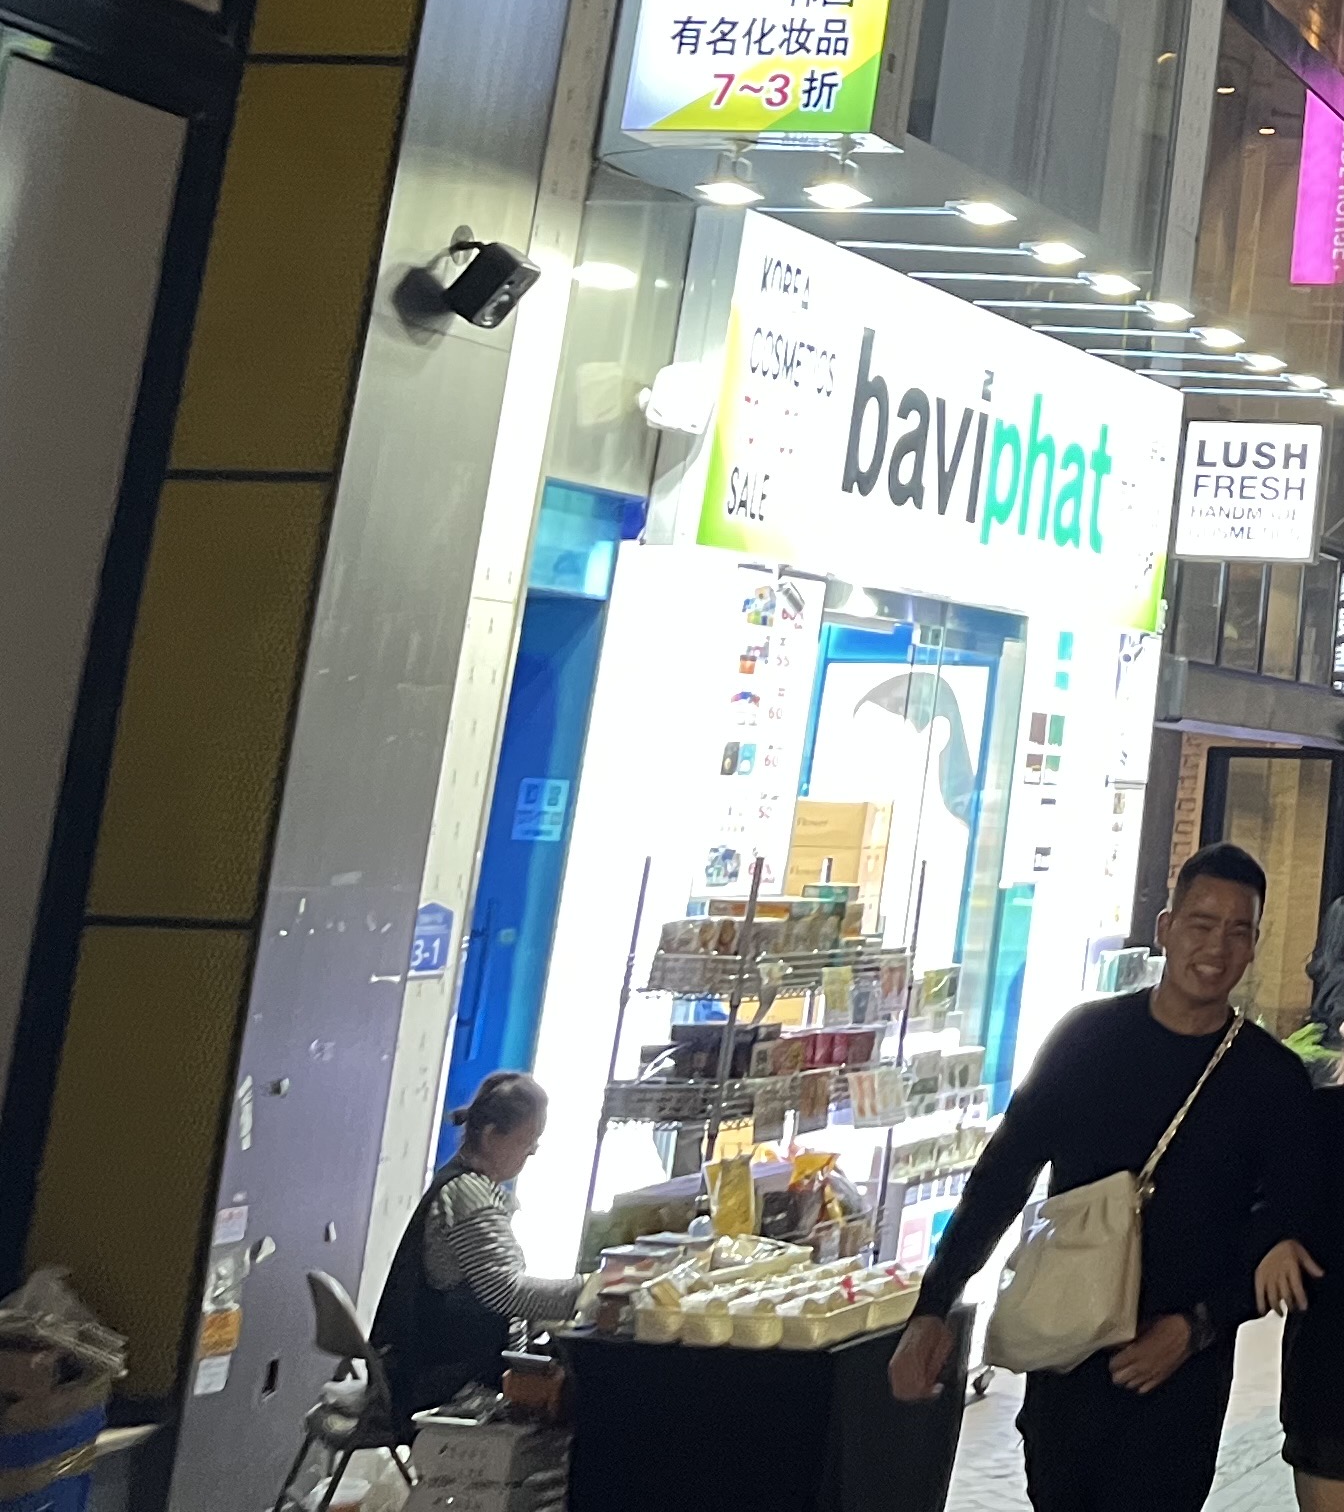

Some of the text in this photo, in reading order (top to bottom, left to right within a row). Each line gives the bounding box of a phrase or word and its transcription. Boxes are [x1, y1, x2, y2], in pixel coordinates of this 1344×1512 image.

[670, 15, 850, 57] 有名化妆品
[709, 69, 839, 111] 7~3 折
[841, 326, 1112, 555] baviphat
[1196, 439, 1309, 471] LUSH
[1193, 474, 1306, 501] FRESH
